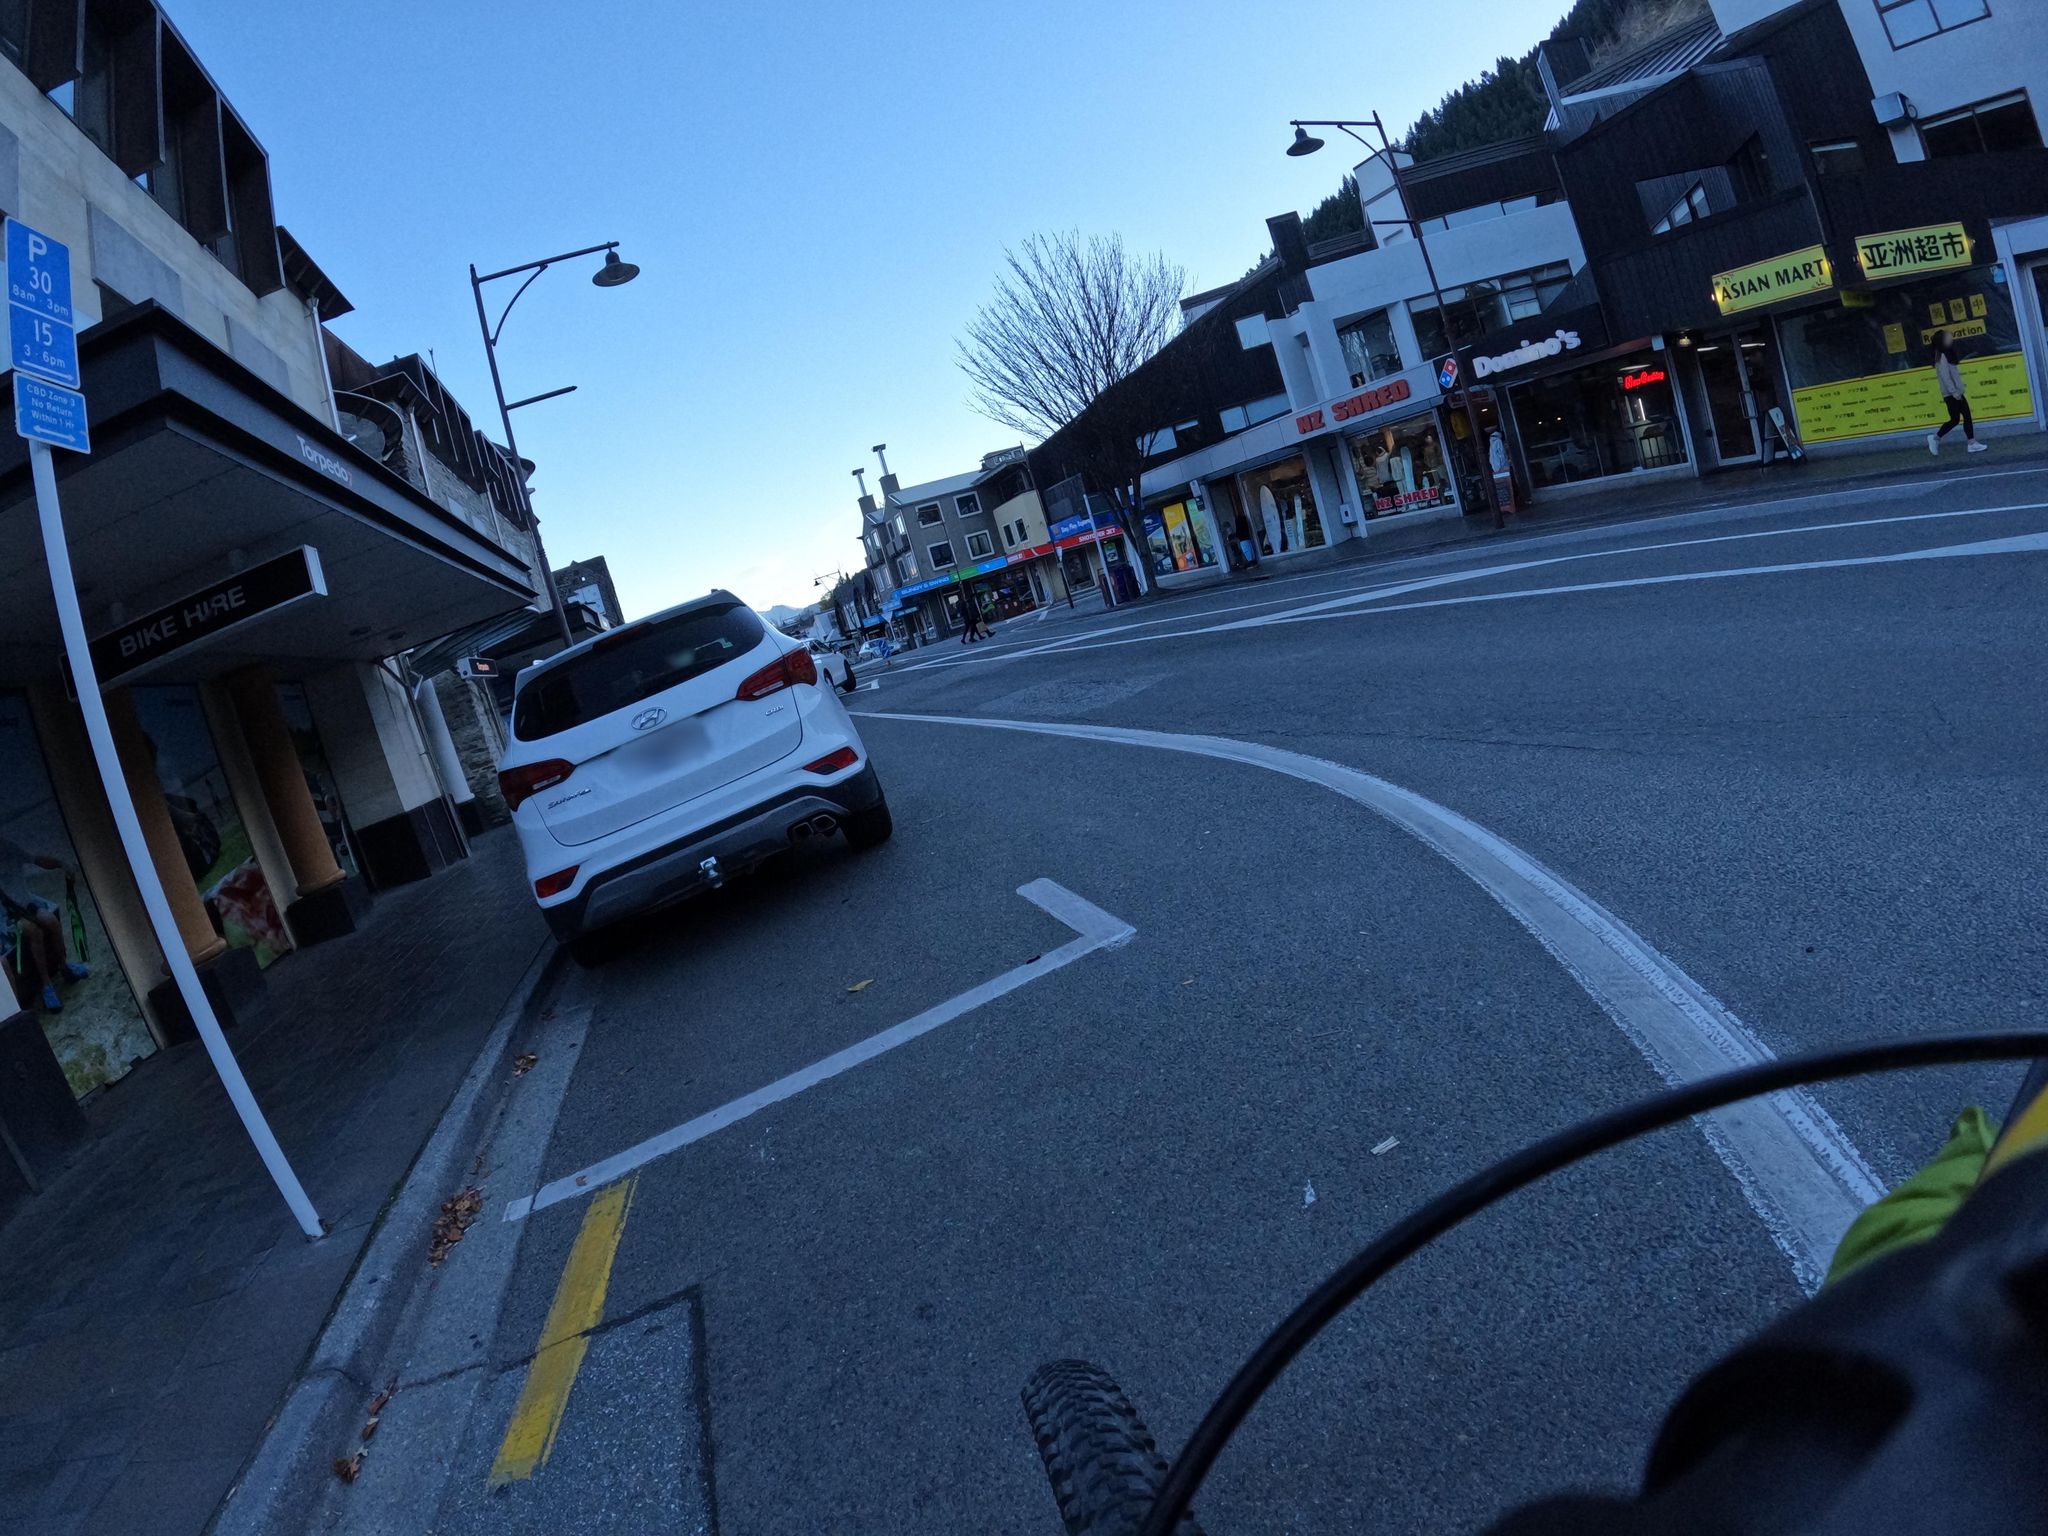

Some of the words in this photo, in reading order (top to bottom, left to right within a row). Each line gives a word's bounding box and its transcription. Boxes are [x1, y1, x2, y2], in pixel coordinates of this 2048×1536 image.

[28, 233, 47, 262] P
[1861, 232, 1965, 270] 亚洲超市
[29, 266, 51, 294] 30
[1721, 274, 1771, 302] ASIAN
[1775, 258, 1824, 286] MART
[12, 284, 36, 302] 8am
[47, 298, 69, 317] 3pm
[34, 319, 52, 347] 15
[1924, 325, 1983, 343] Rvation
[23, 344, 31, 356] 3
[42, 351, 66, 369] 6pm
[1472, 329, 1581, 378] Domino's
[26, 384, 46, 397] CBD
[48, 391, 68, 405] Zone
[31, 398, 44, 408] No
[46, 403, 73, 418] Return
[1296, 410, 1326, 434] NZ
[1331, 379, 1411, 422] SHRED
[31, 410, 58, 425] Within
[1374, 497, 1393, 510] NZ
[1393, 486, 1439, 507] SHRED
[1078, 531, 1105, 543] SHOTOER
[119, 616, 178, 657] BIKE
[183, 585, 247, 628] HIRE
